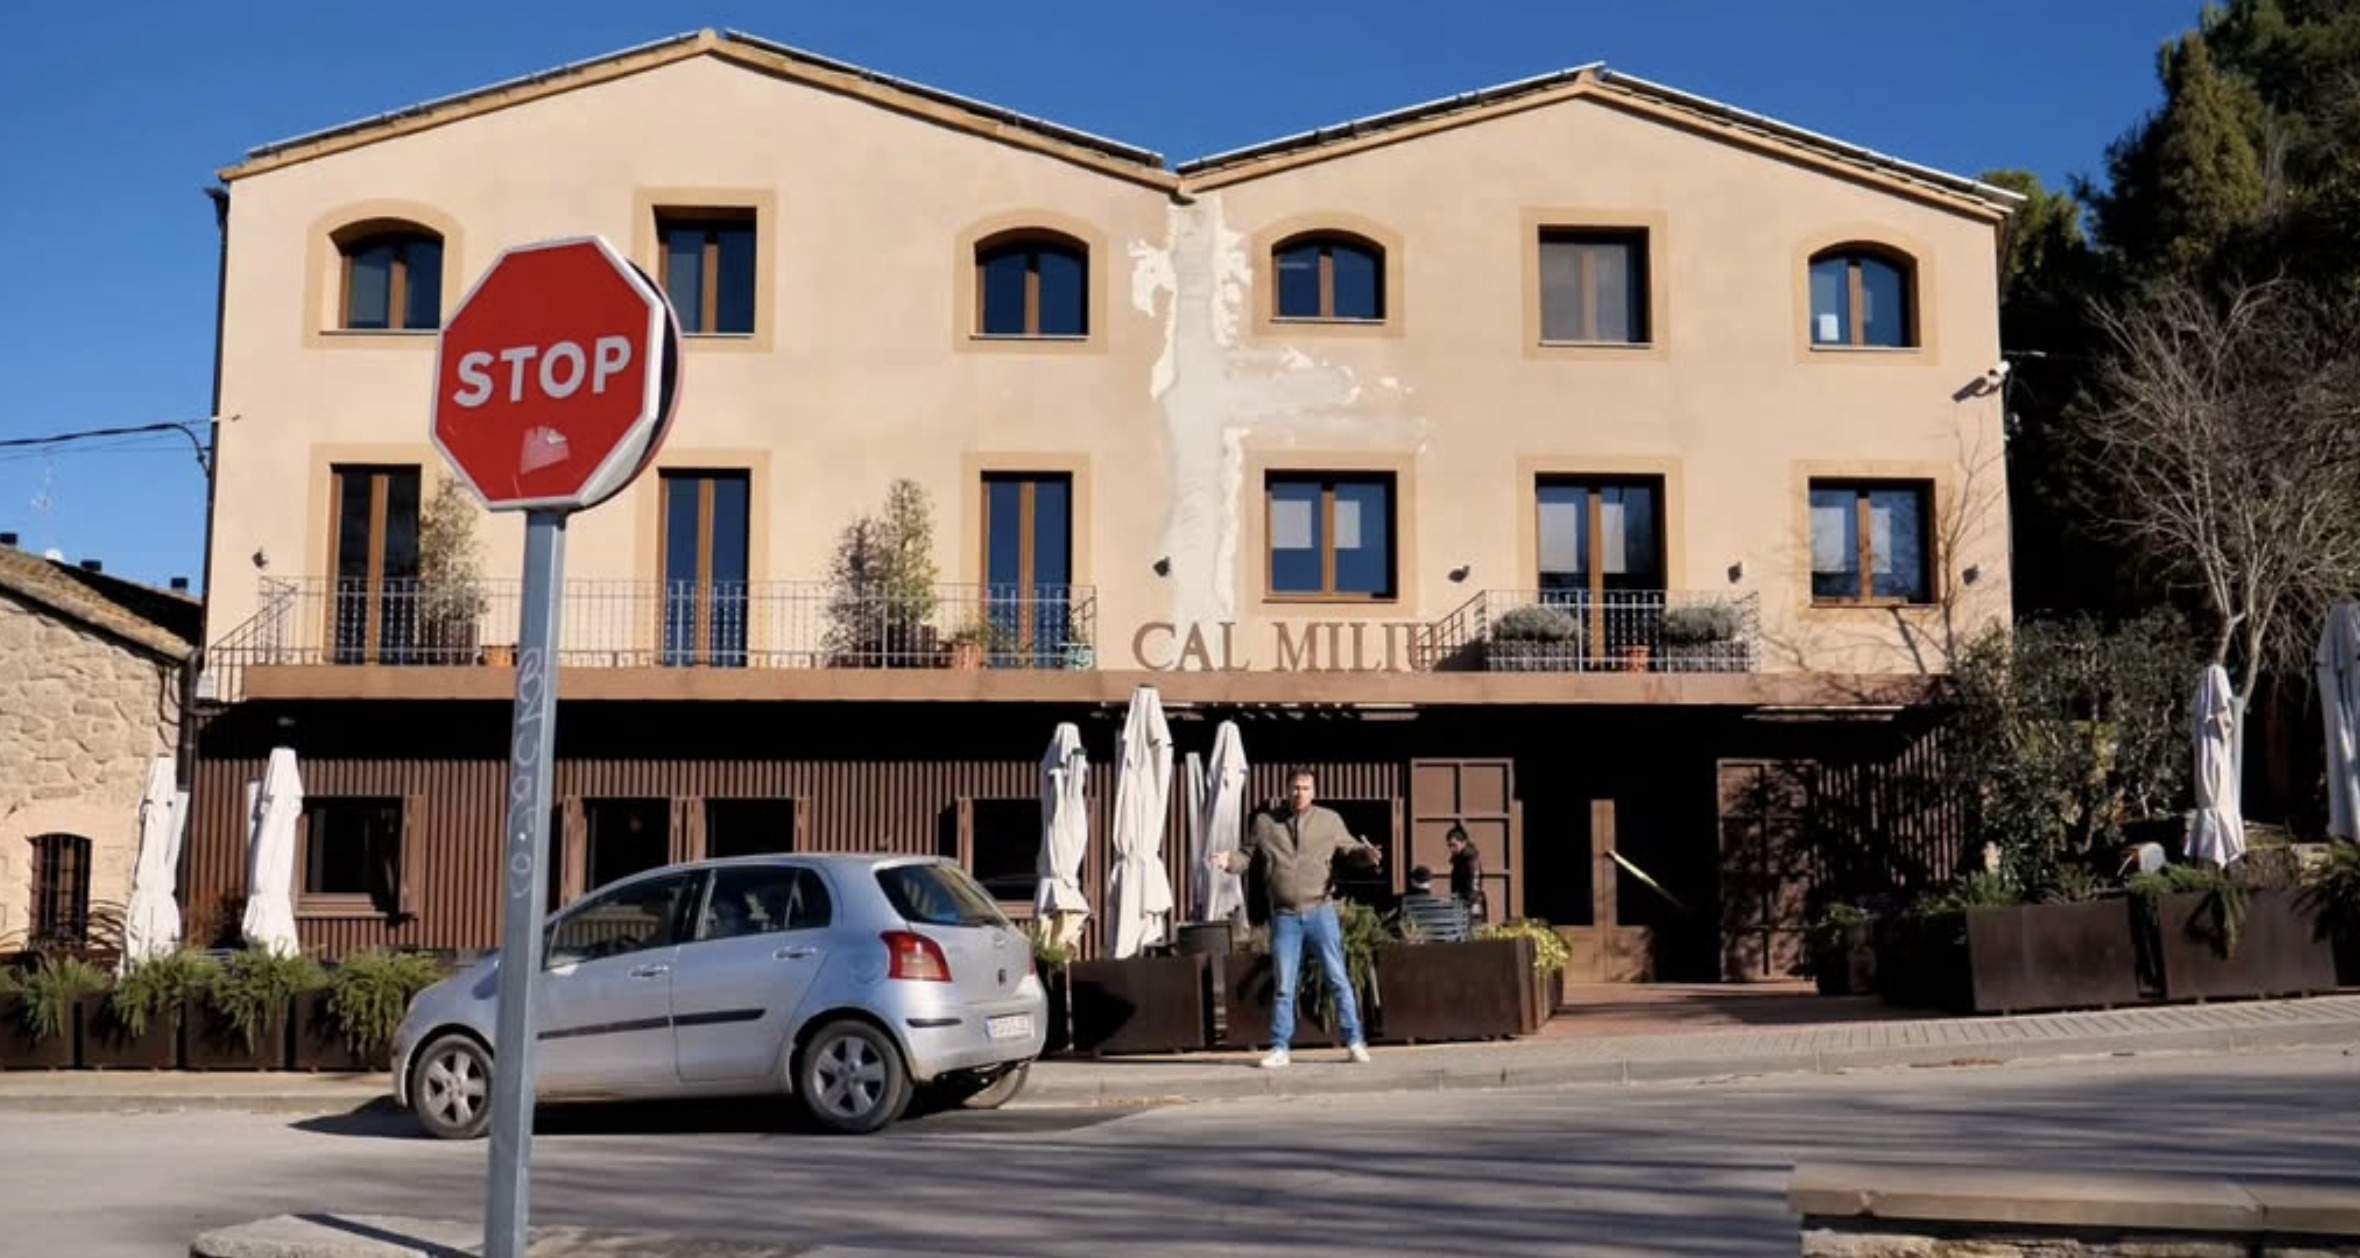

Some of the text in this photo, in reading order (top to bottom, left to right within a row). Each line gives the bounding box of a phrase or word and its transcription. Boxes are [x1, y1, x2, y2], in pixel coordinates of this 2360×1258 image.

[453, 335, 632, 408] STOP
[1132, 621, 1440, 672] CAL MILIU
